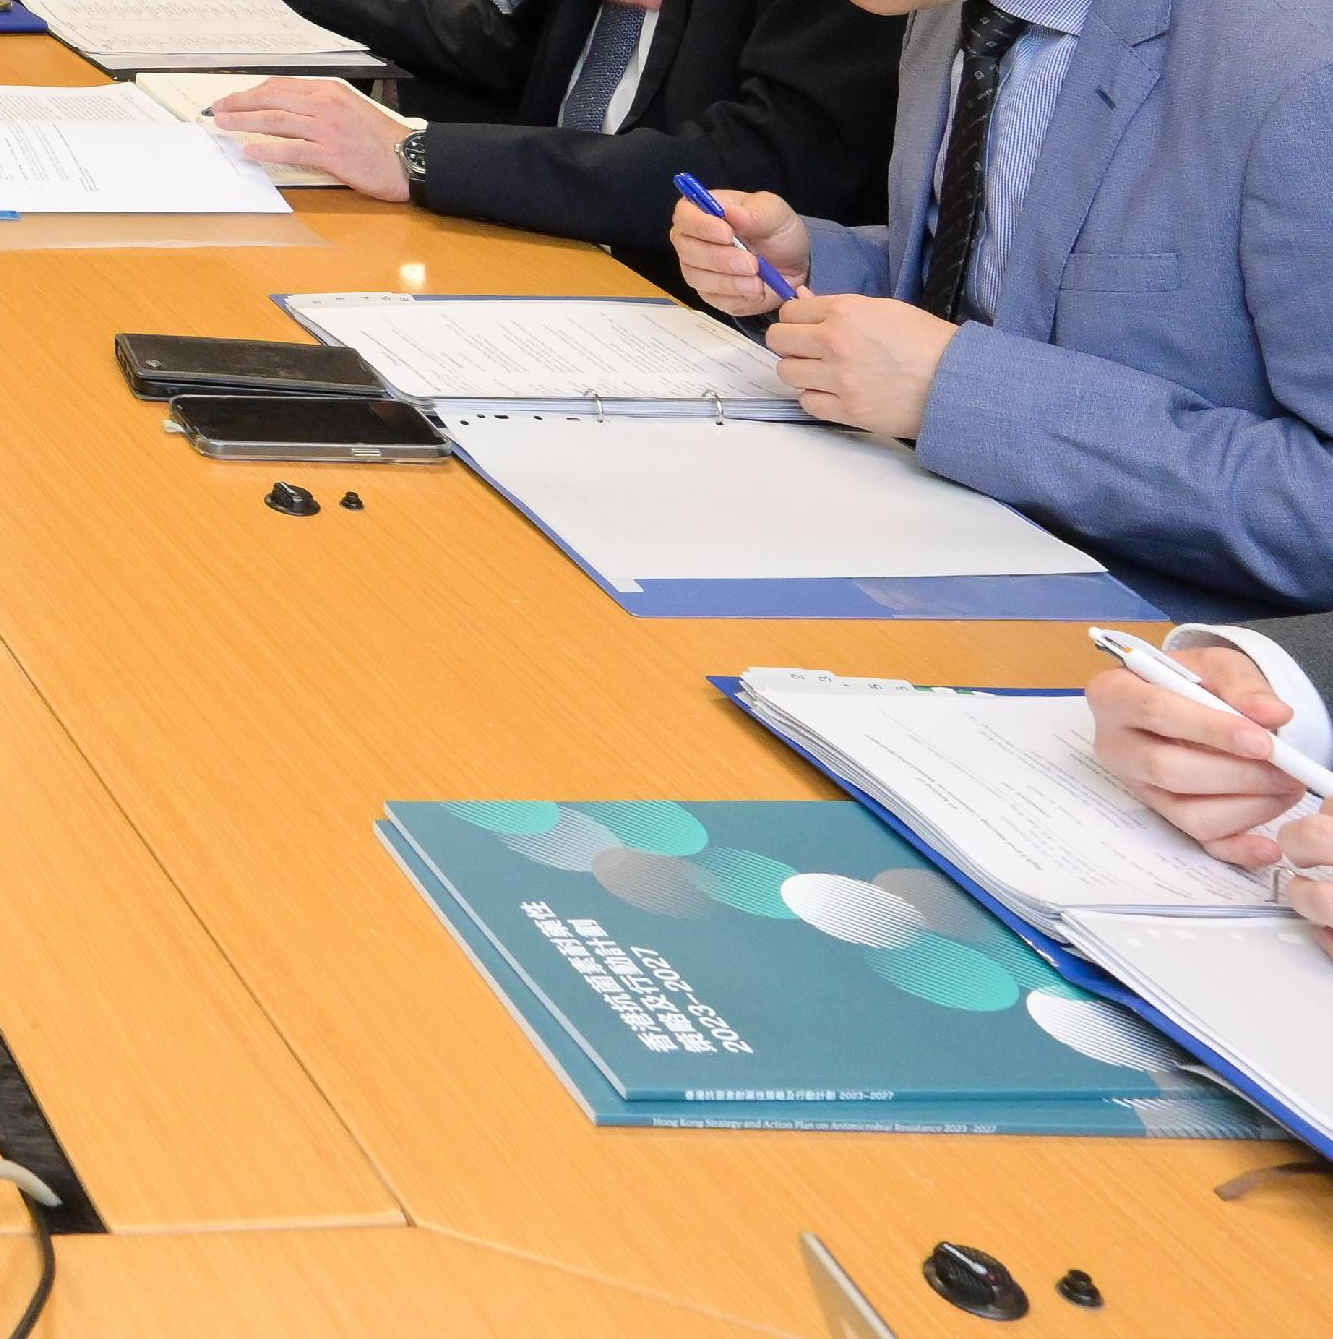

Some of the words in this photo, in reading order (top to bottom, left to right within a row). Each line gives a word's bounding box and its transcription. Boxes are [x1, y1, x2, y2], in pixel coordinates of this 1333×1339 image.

[567, 919, 718, 1053] 策略及行動計劃
